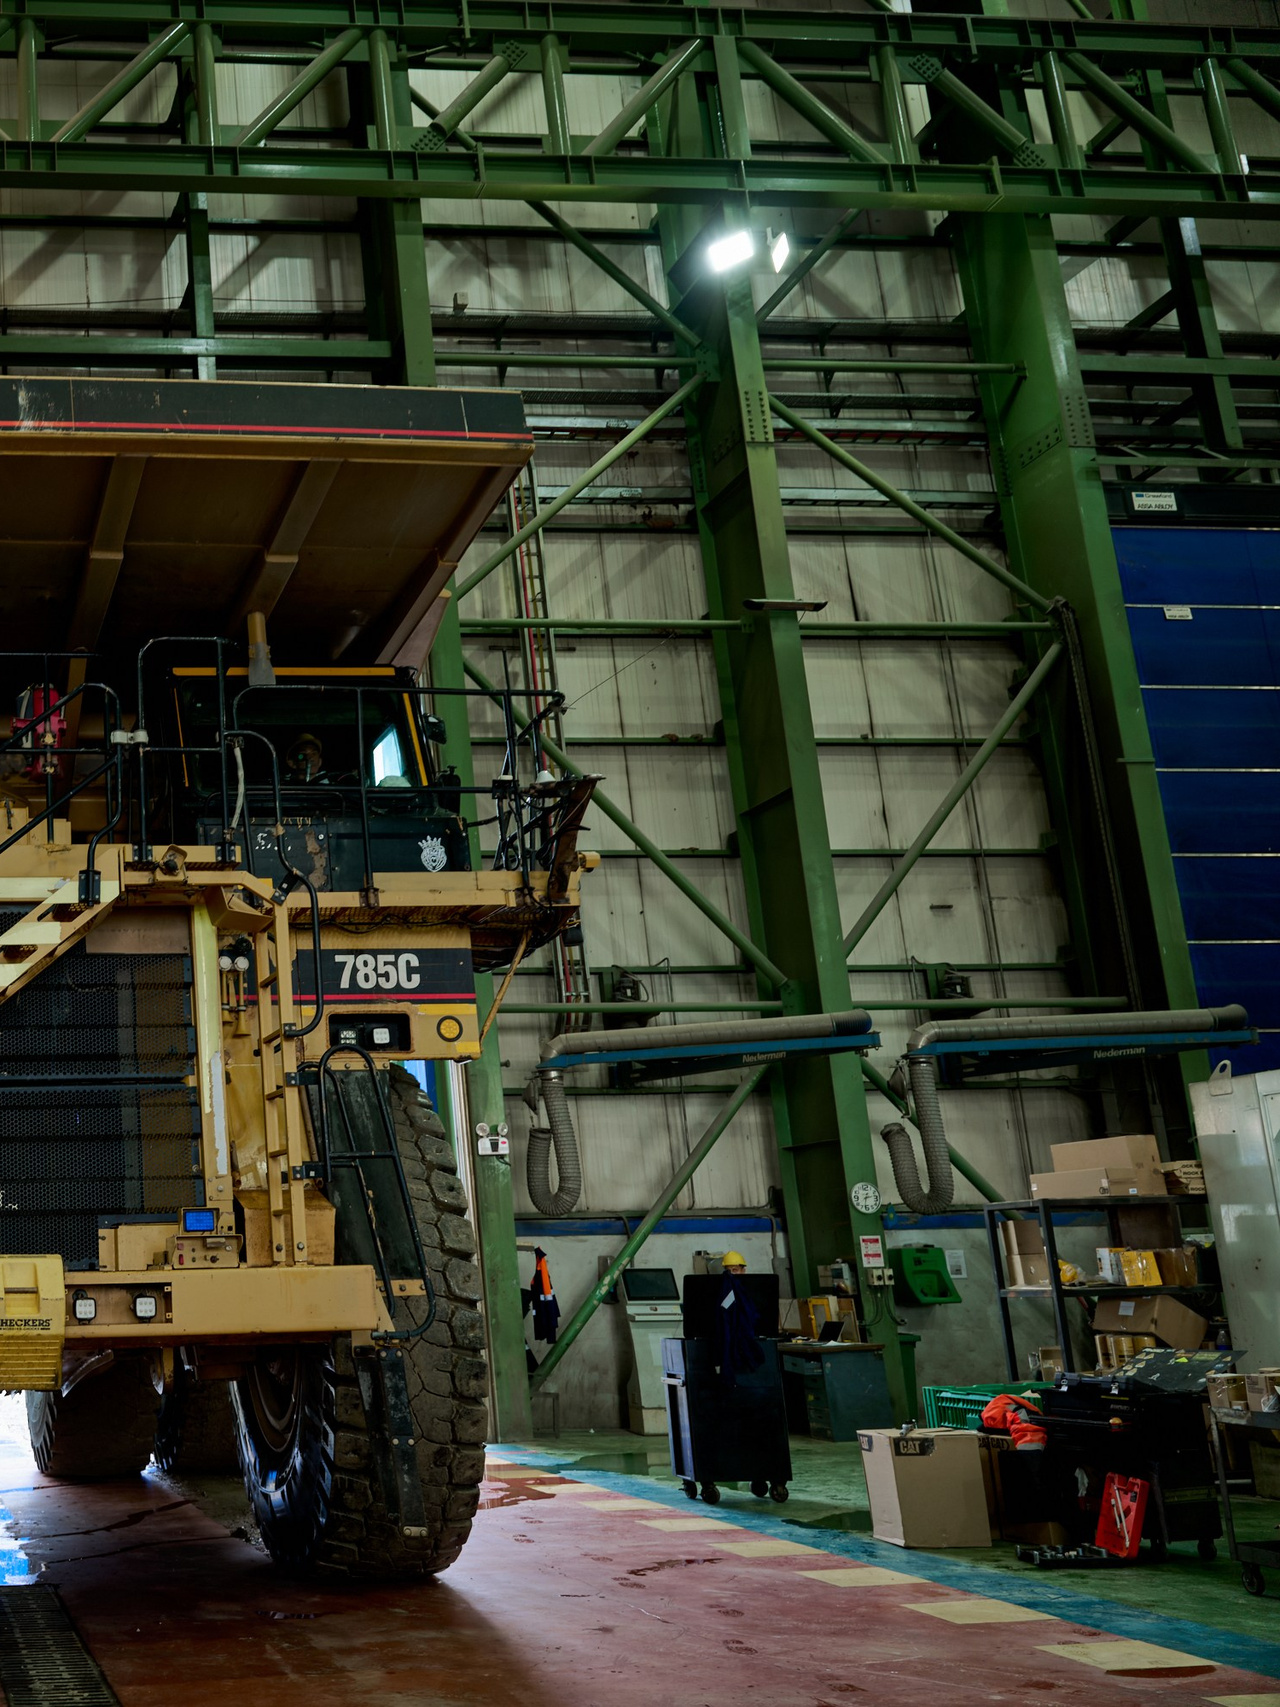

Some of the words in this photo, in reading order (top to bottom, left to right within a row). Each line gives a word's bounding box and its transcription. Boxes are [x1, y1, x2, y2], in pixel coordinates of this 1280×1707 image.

[334, 953, 420, 989] 785C
[742, 1051, 787, 1063] Nederman
[1093, 1047, 1146, 1059] Nederman
[899, 1440, 920, 1454] CAT
[991, 1437, 1004, 1448] CAT
